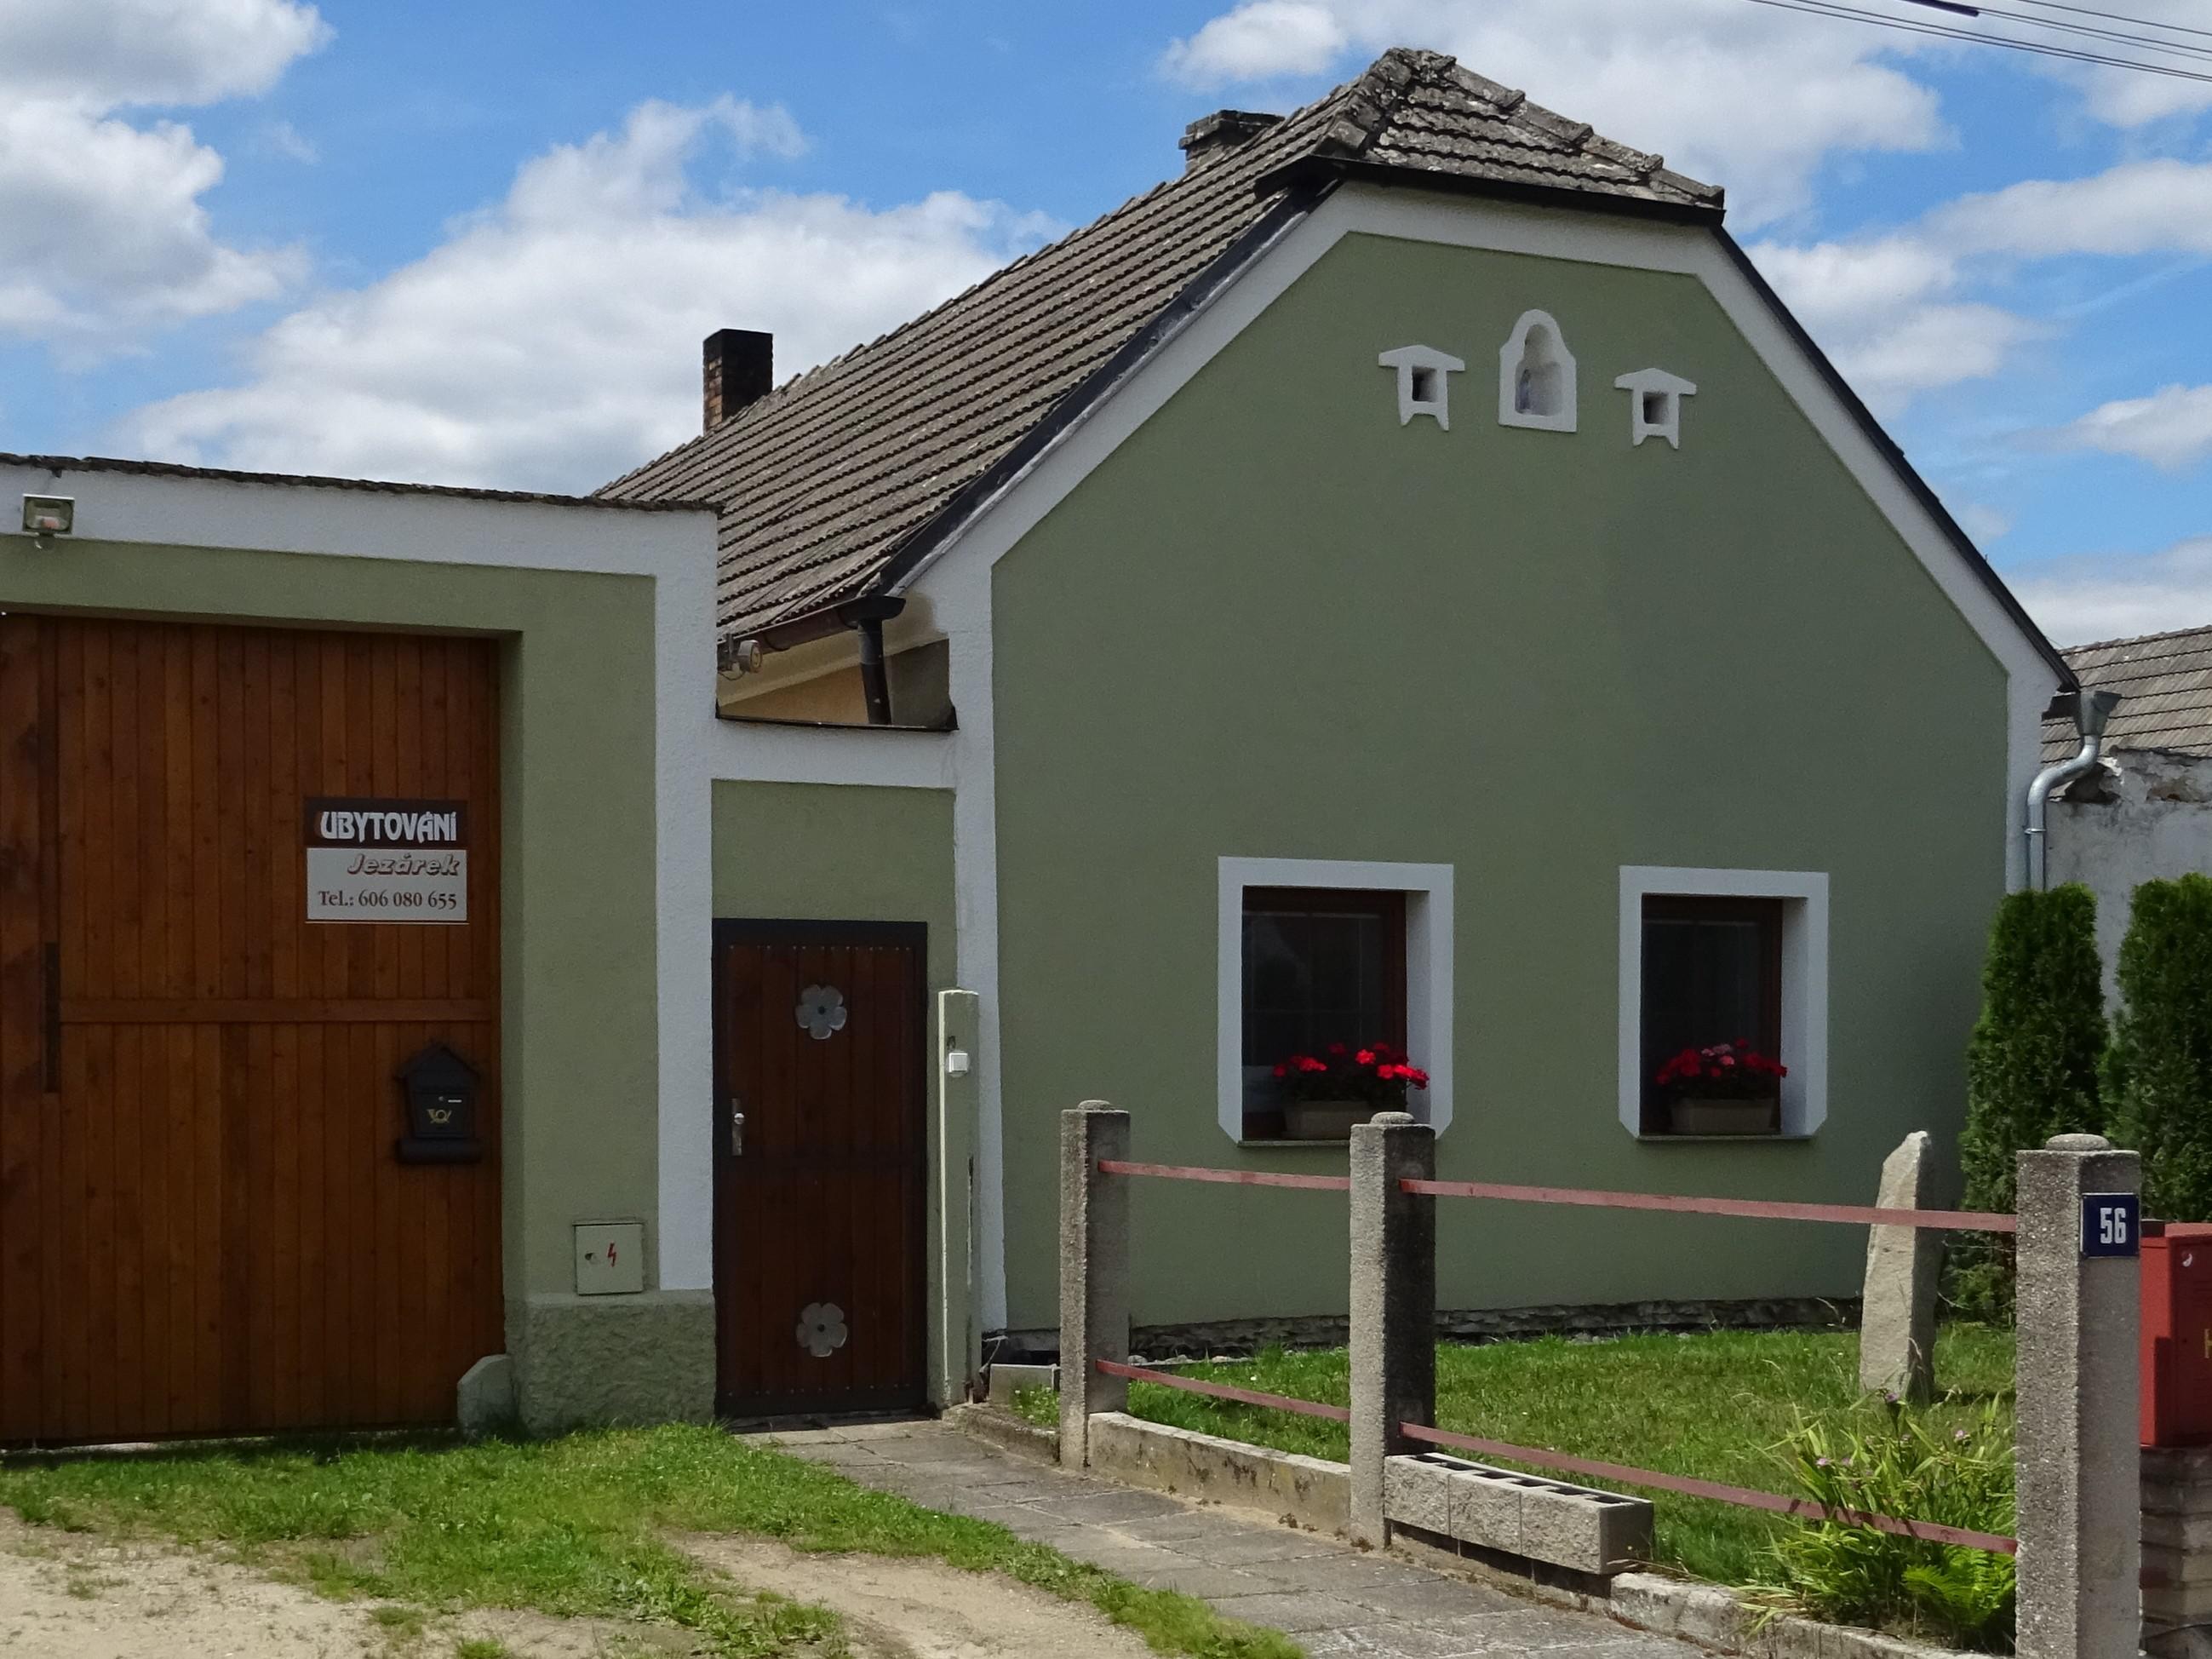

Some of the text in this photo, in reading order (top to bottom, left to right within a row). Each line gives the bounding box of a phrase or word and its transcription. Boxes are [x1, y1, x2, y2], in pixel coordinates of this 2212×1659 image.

[320, 811, 457, 842] UBYTOVÁNÍ
[347, 852, 460, 876] Jezárek
[318, 889, 457, 910] Tel.: 606 080 655
[2100, 1208, 2126, 1243] 56
